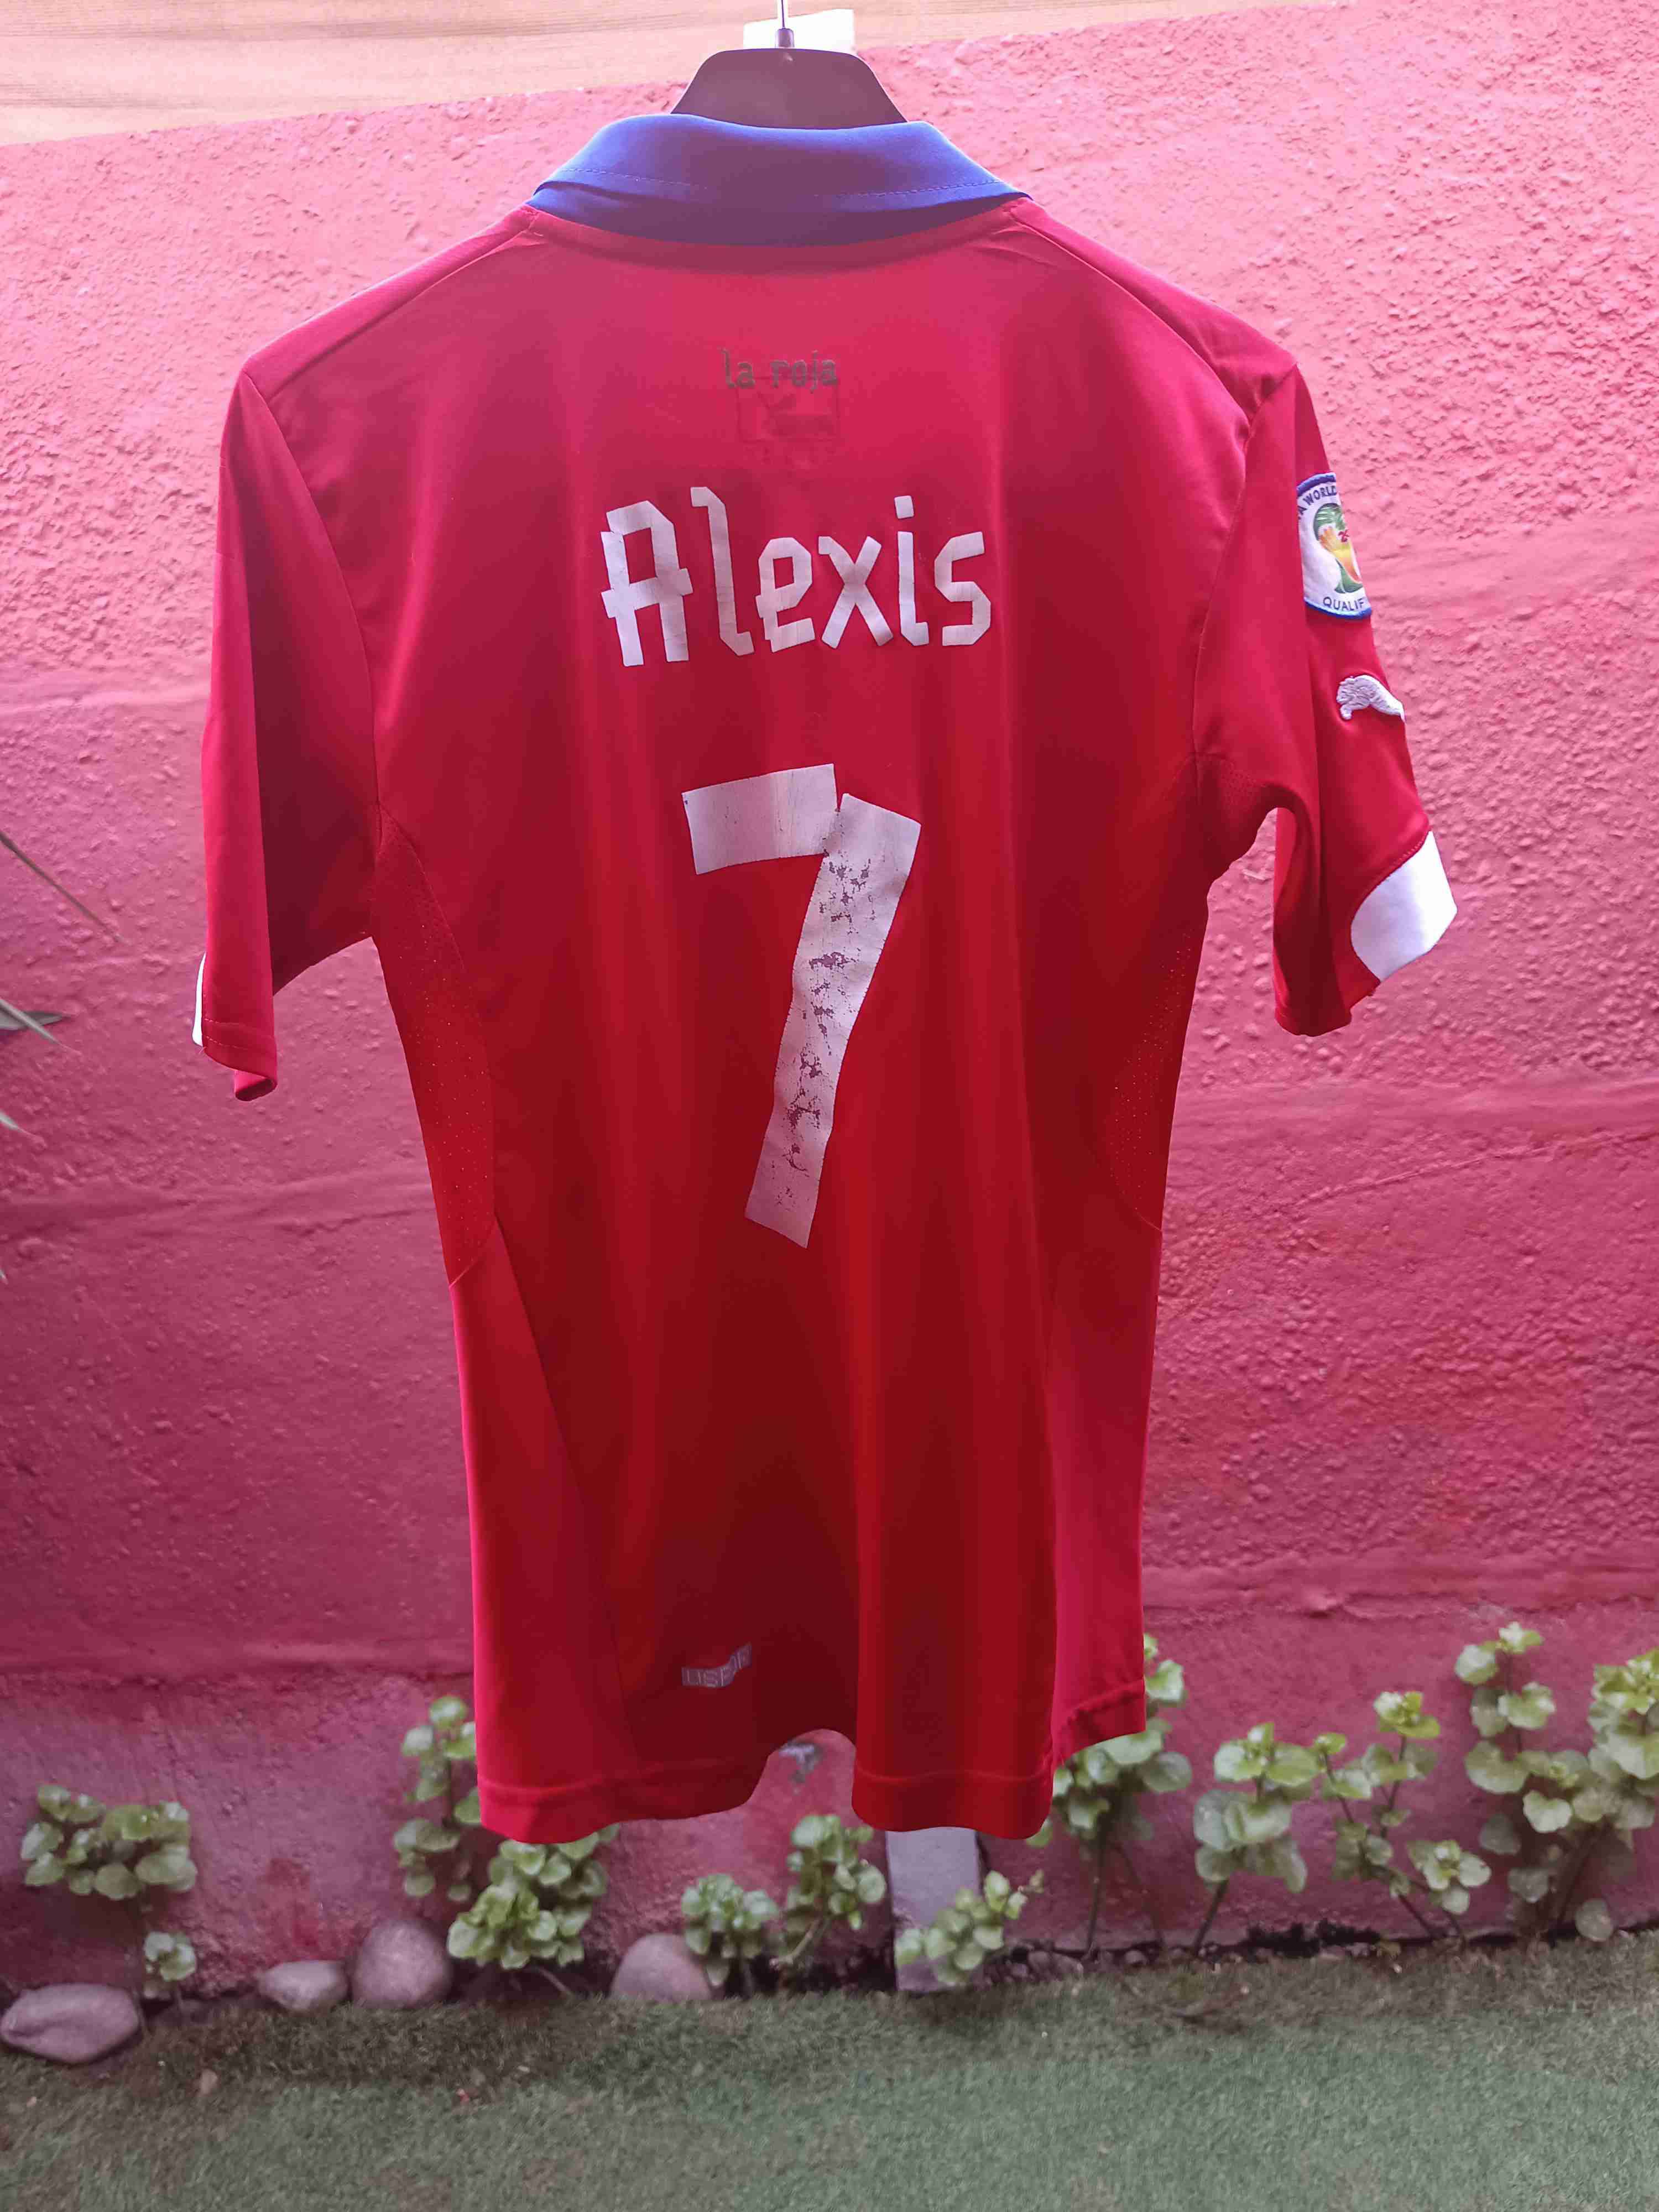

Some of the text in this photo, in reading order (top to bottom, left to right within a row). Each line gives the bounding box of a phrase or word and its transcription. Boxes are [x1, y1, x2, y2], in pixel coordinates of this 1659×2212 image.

[720, 347, 838, 394] la roja
[1302, 485, 1337, 505] WORLD
[601, 487, 992, 666] Alexis
[681, 763, 921, 1249] 7
